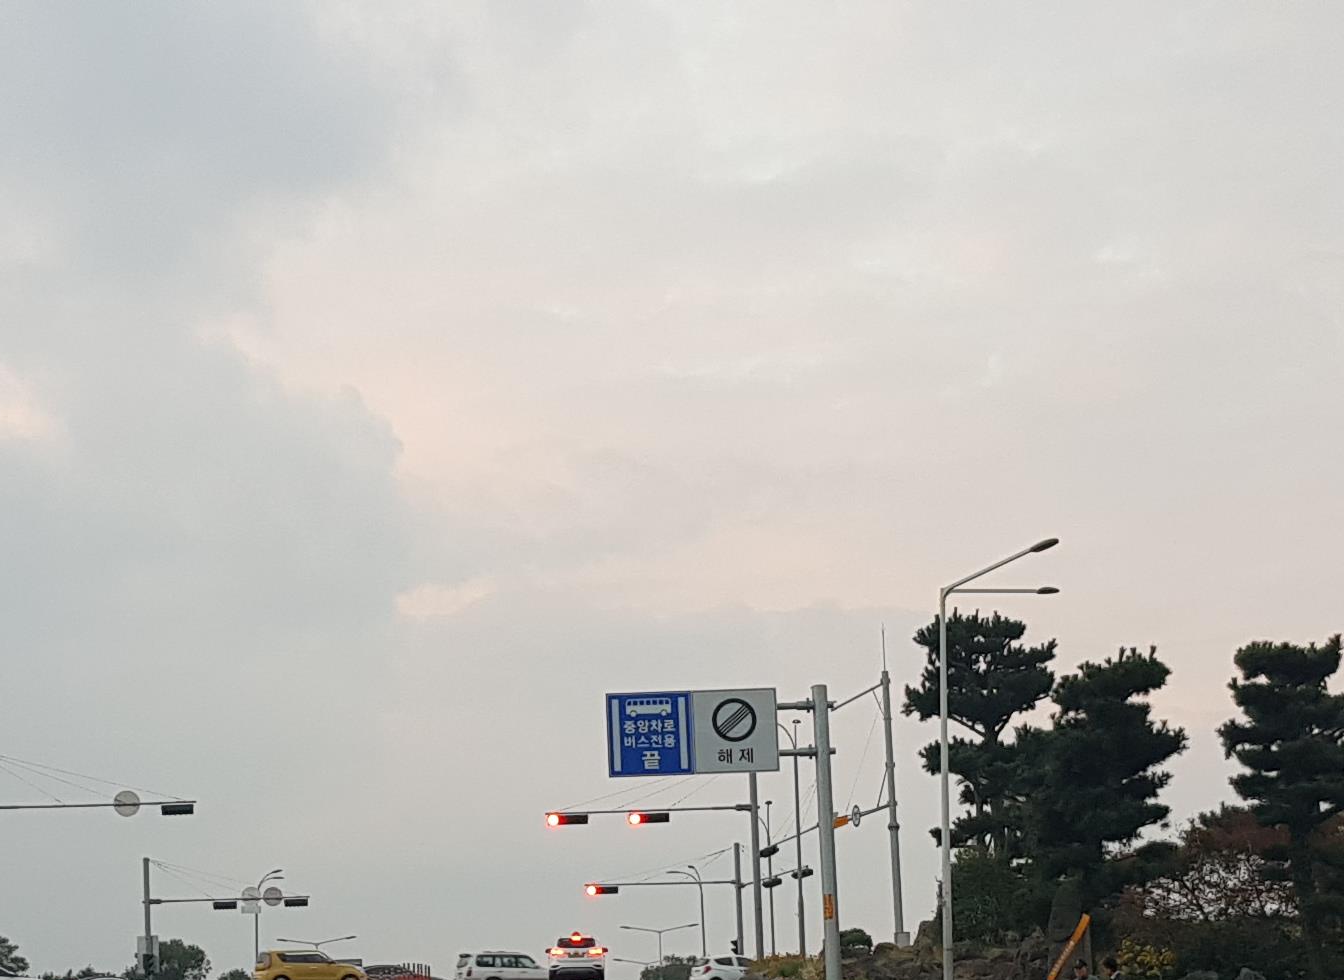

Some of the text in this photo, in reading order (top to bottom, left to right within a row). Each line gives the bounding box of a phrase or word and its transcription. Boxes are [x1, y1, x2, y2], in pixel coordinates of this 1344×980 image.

[623, 719, 676, 734] 중앙차로
[624, 734, 676, 748] 버스전용
[642, 751, 661, 770] 끝
